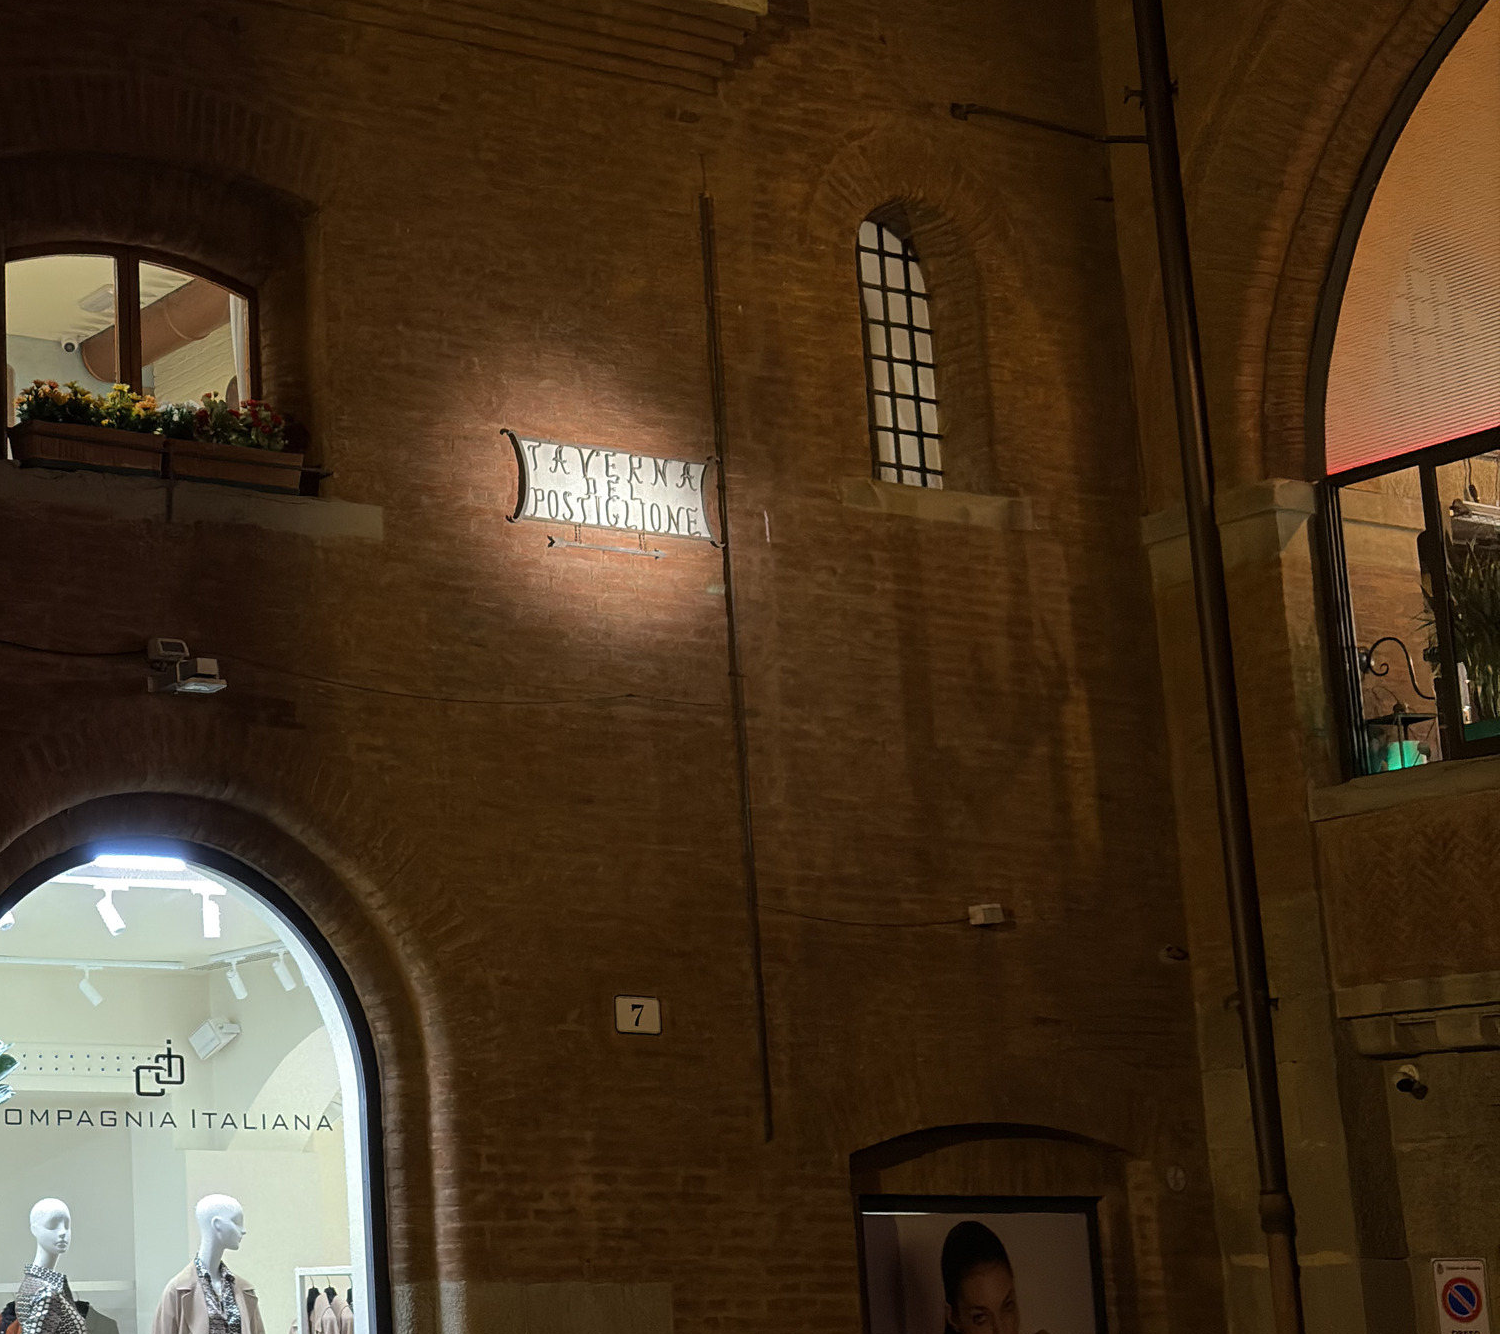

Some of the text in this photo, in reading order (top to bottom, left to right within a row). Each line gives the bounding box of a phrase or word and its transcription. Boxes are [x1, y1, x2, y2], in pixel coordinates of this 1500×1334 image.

[527, 442, 698, 491] TAVERNA
[584, 477, 642, 501] DEL
[529, 486, 701, 536] POSTIGLIONE
[630, 1003, 644, 1027] 7
[191, 1108, 334, 1132] ITALIANA
